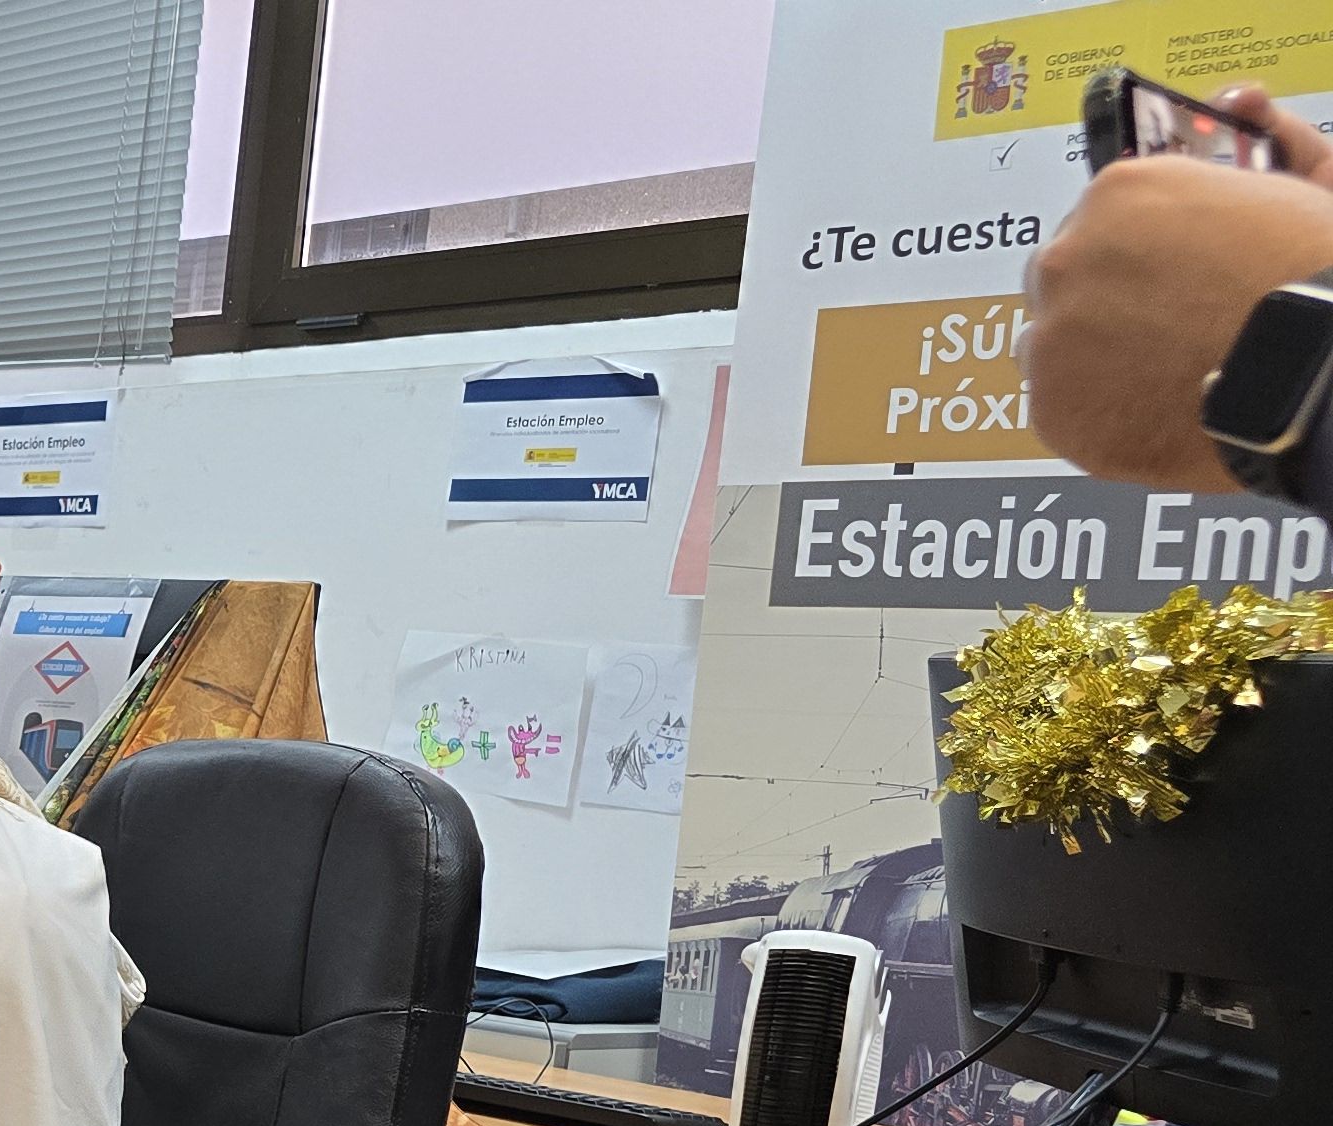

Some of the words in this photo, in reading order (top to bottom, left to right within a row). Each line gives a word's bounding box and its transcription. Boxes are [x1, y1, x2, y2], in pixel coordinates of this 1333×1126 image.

[1166, 50, 1187, 64] DE
[1190, 40, 1273, 61] DERECHOS
[1276, 30, 1333, 50] SOCIALE
[1168, 26, 1253, 48] MINISTERIO
[1046, 45, 1124, 67] GOBIERNO
[1165, 67, 1178, 79] Y
[1179, 58, 1242, 77] AGENDA
[1246, 53, 1279, 69] 2030
[1044, 68, 1064, 82] DE
[802, 226, 876, 271] ¿Te
[891, 212, 1041, 259] cuesta
[886, 377, 1030, 434] Próxi
[507, 414, 555, 428] Estación
[559, 414, 605, 428] Empleo
[2, 436, 45, 450] Estación
[48, 436, 86, 450] Empleo
[592, 482, 638, 499] YMCA
[58, 498, 92, 513] YMCA
[794, 493, 1107, 579] Estación
[1137, 493, 1333, 601] Emp
[455, 646, 526, 673] KRISTINA
